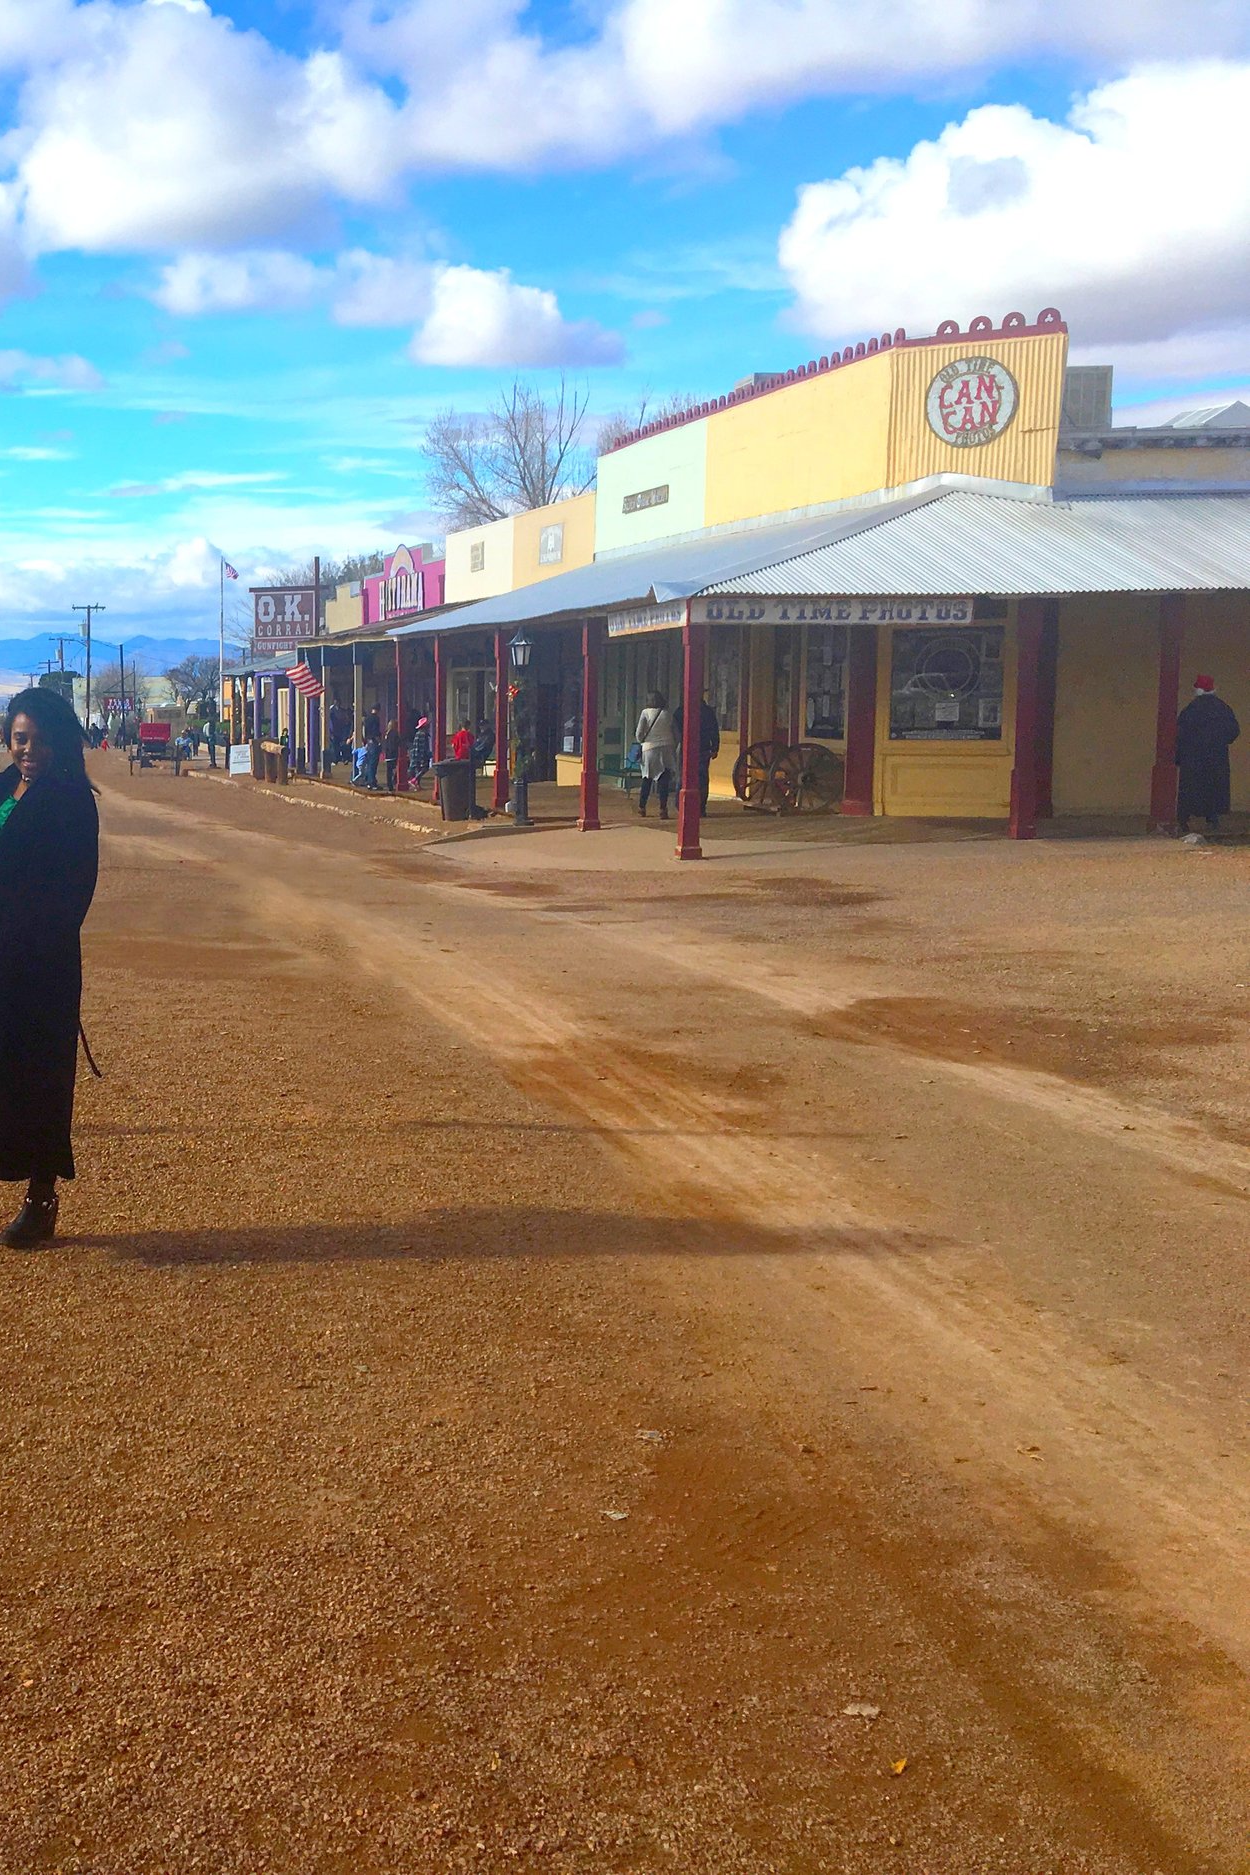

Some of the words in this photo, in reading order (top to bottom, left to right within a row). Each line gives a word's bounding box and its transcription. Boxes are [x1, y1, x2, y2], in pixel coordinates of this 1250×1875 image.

[942, 400, 999, 435] CAN
[258, 594, 310, 623] O.K.
[708, 600, 765, 620] OLD
[775, 600, 851, 620] TIME
[858, 600, 969, 620] PHOTOS
[257, 623, 311, 636] CORRAL
[257, 641, 294, 651] GUNFIGHT
